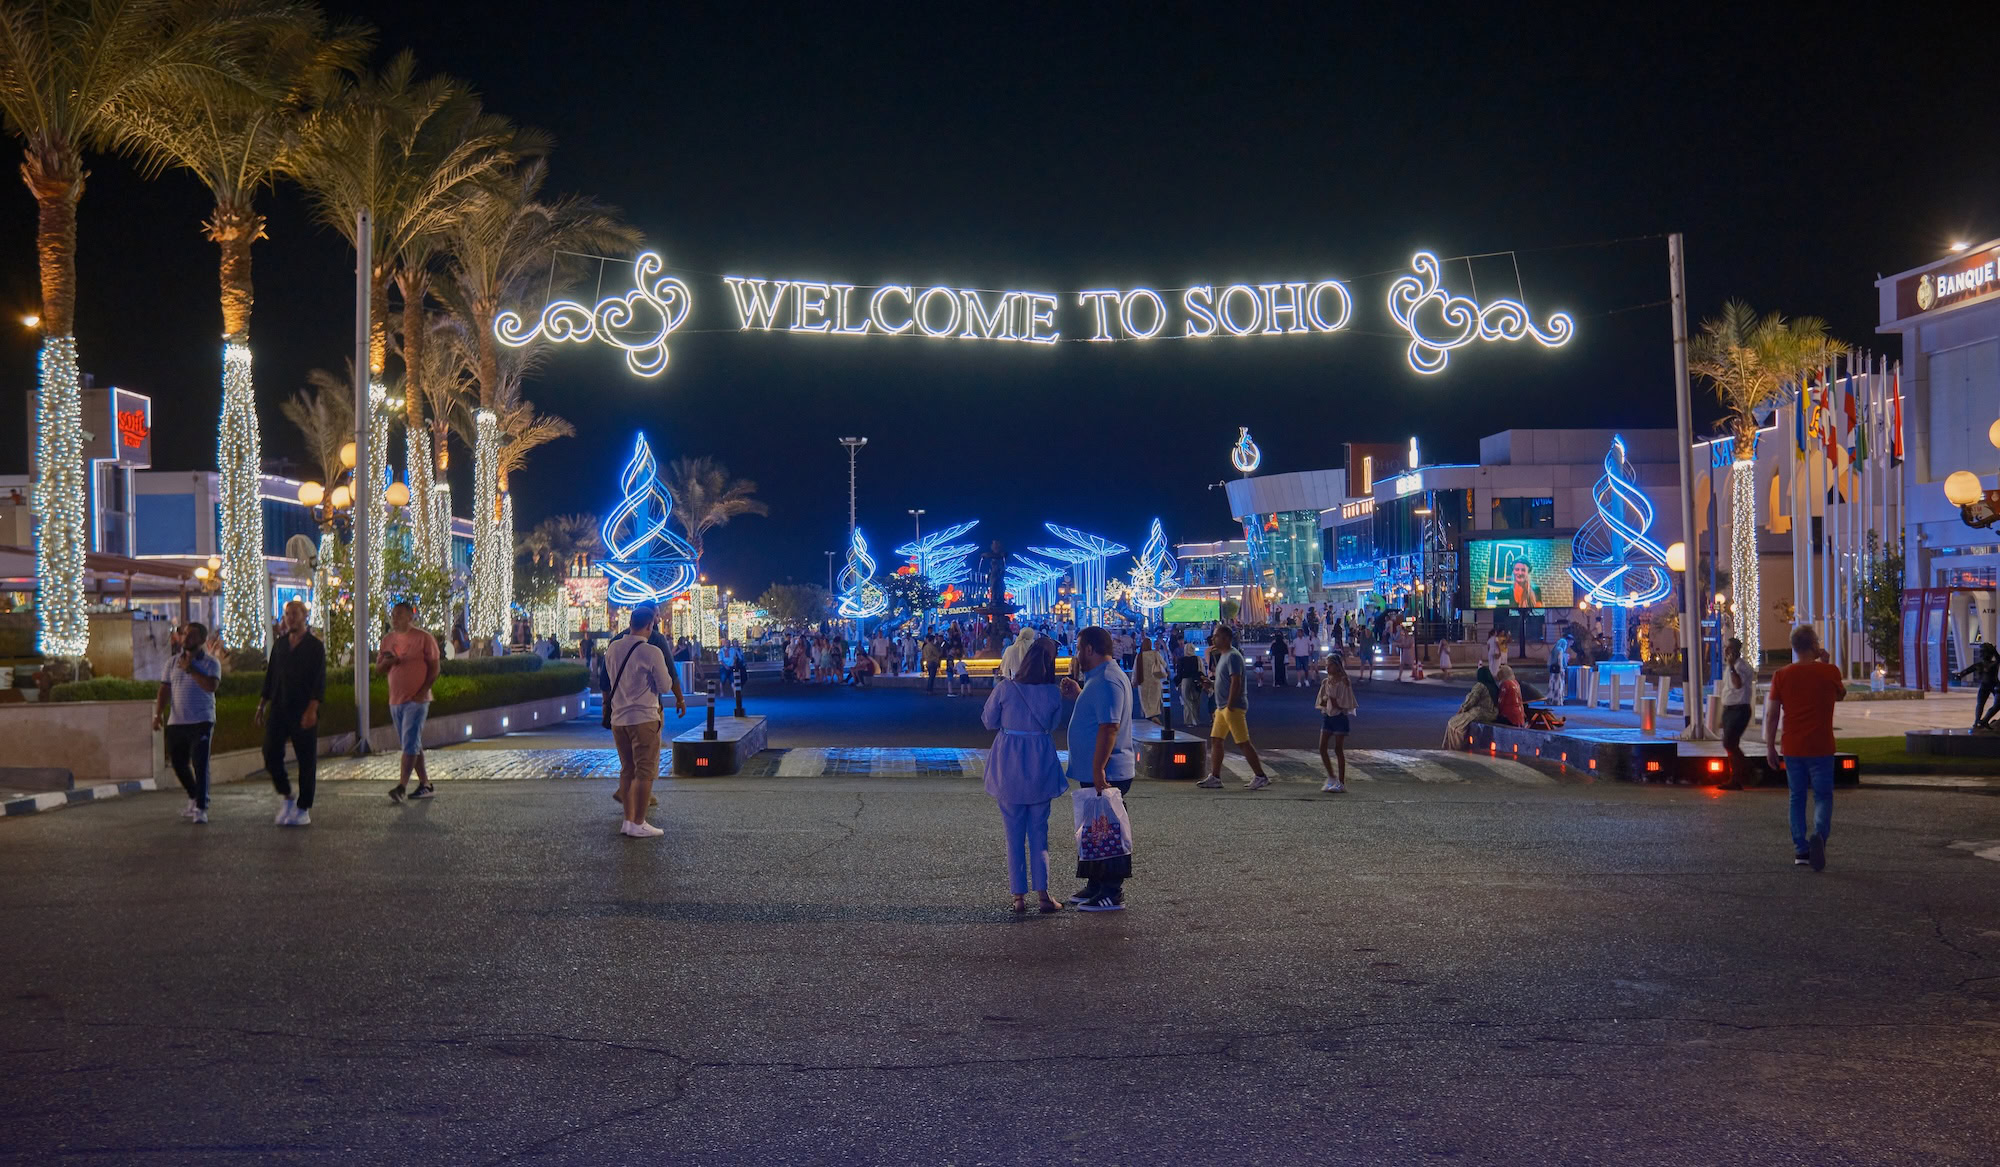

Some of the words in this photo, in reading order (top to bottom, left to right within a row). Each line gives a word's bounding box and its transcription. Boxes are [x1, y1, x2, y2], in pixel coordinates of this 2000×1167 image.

[1937, 261, 1994, 298] BANQUE
[724, 276, 1058, 344] WELCOME
[1079, 290, 1167, 341] TO
[1184, 280, 1351, 337] SOHO
